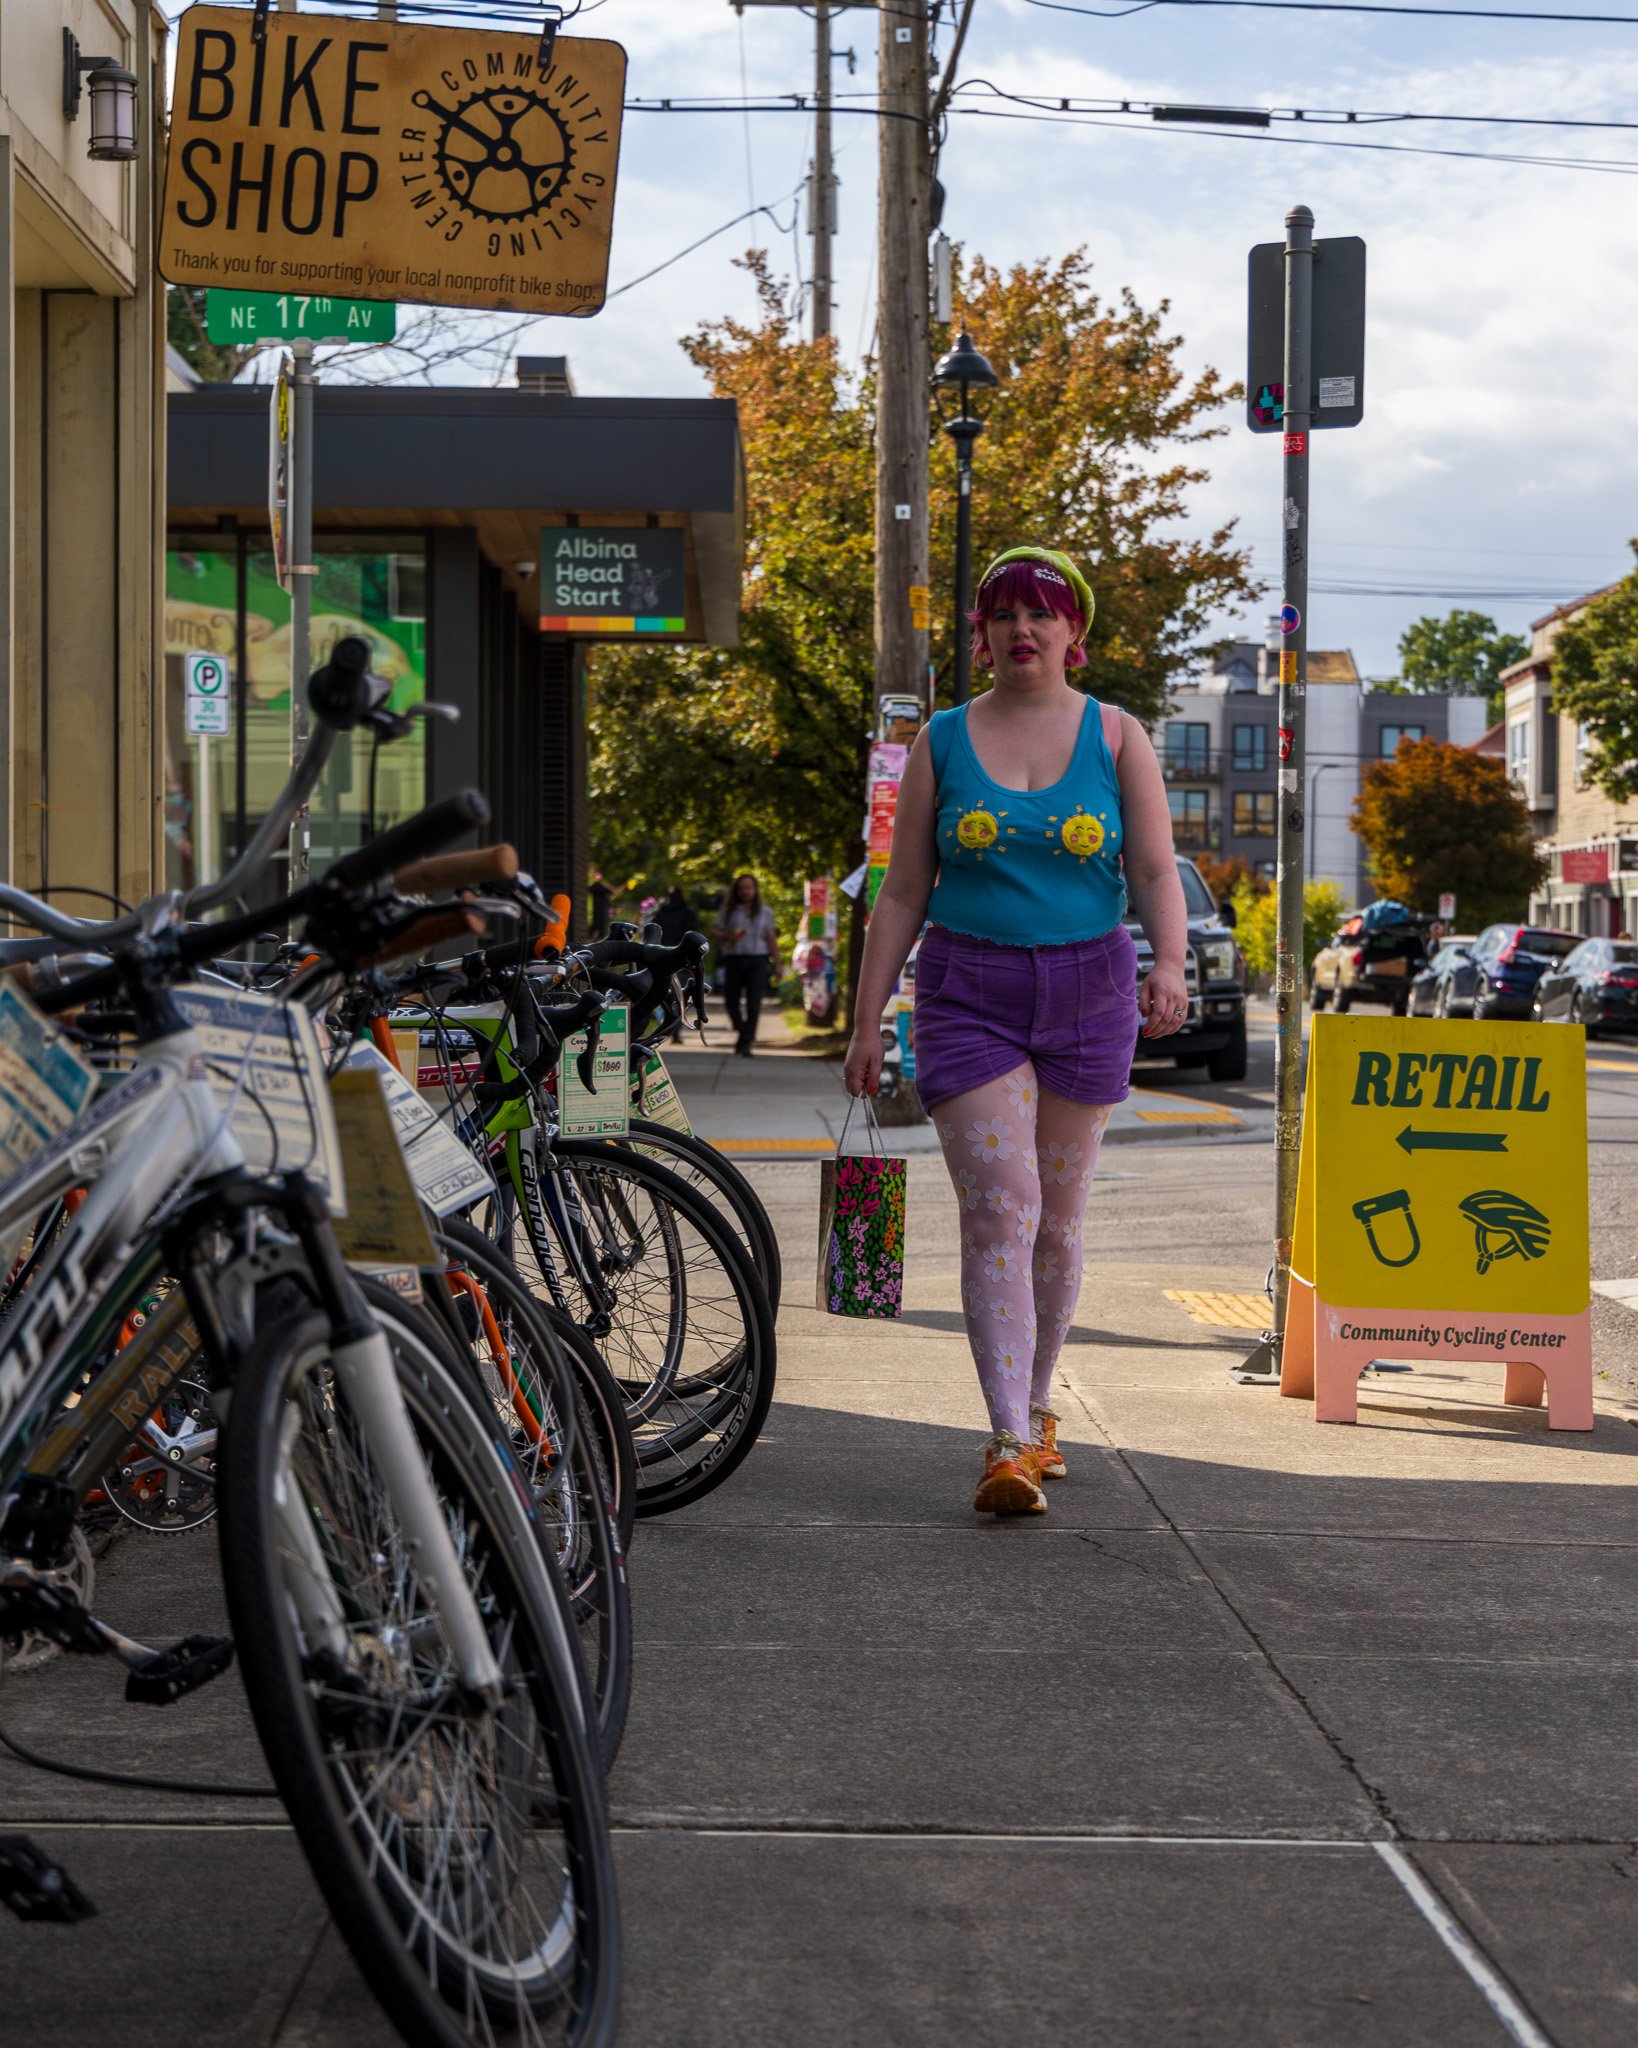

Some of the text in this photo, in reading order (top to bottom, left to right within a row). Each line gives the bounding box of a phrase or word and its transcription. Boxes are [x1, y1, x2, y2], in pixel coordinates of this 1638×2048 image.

[187, 28, 389, 136] BIKE
[440, 52, 609, 146] COMMUNITY
[177, 137, 379, 238] SHOP
[399, 127, 465, 242] CENTER
[487, 172, 606, 258] CYCLING
[173, 248, 596, 302] Thank you for supporting your local nonprofit bike shop.
[231, 306, 256, 329] NE
[347, 306, 373, 329] Av
[555, 538, 638, 559] Albina
[556, 562, 624, 583] Head
[556, 584, 622, 607] Start
[202, 665, 216, 687] P
[1351, 1051, 1550, 1113] RETAIL
[559, 1160, 642, 1184] ASTON
[520, 1148, 569, 1309] cannondale
[1339, 1322, 1567, 1350] Community Cycling Center
[700, 1394, 750, 1472] EASTON
